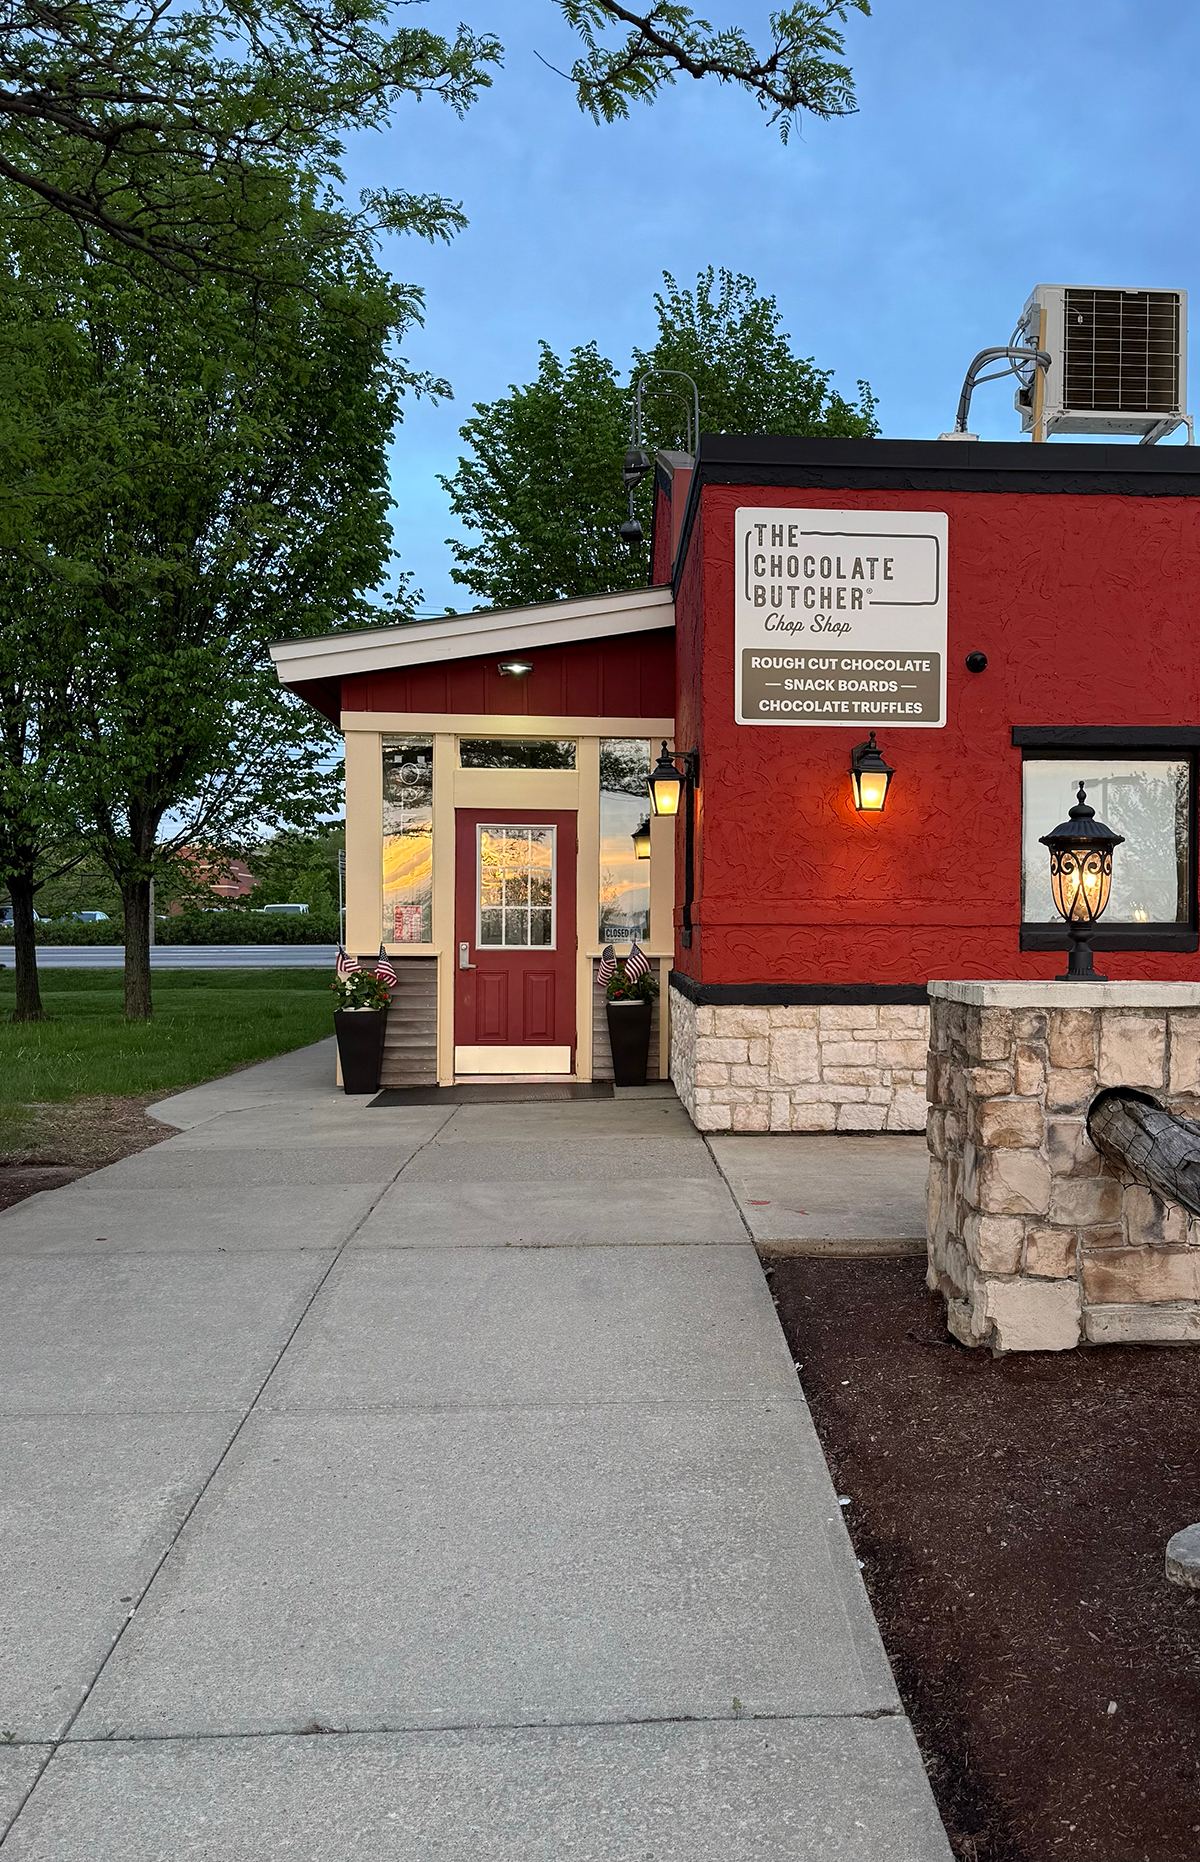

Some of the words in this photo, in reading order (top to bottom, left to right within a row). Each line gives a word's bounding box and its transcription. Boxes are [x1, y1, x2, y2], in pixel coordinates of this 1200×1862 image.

[753, 523, 799, 547] THE
[753, 554, 894, 580] CHOCOLATE
[764, 612, 805, 636] Chop
[809, 614, 853, 637] Shop
[751, 656, 805, 670] ROUGH
[808, 657, 838, 671] CUT
[840, 658, 931, 672] CHOCOLATE
[783, 678, 836, 692] SNACK
[838, 679, 898, 693] BOARDS
[758, 699, 849, 713] CHOCOLATE
[852, 700, 923, 714] TRUFFLES
[606, 928, 629, 938] CLOSED
